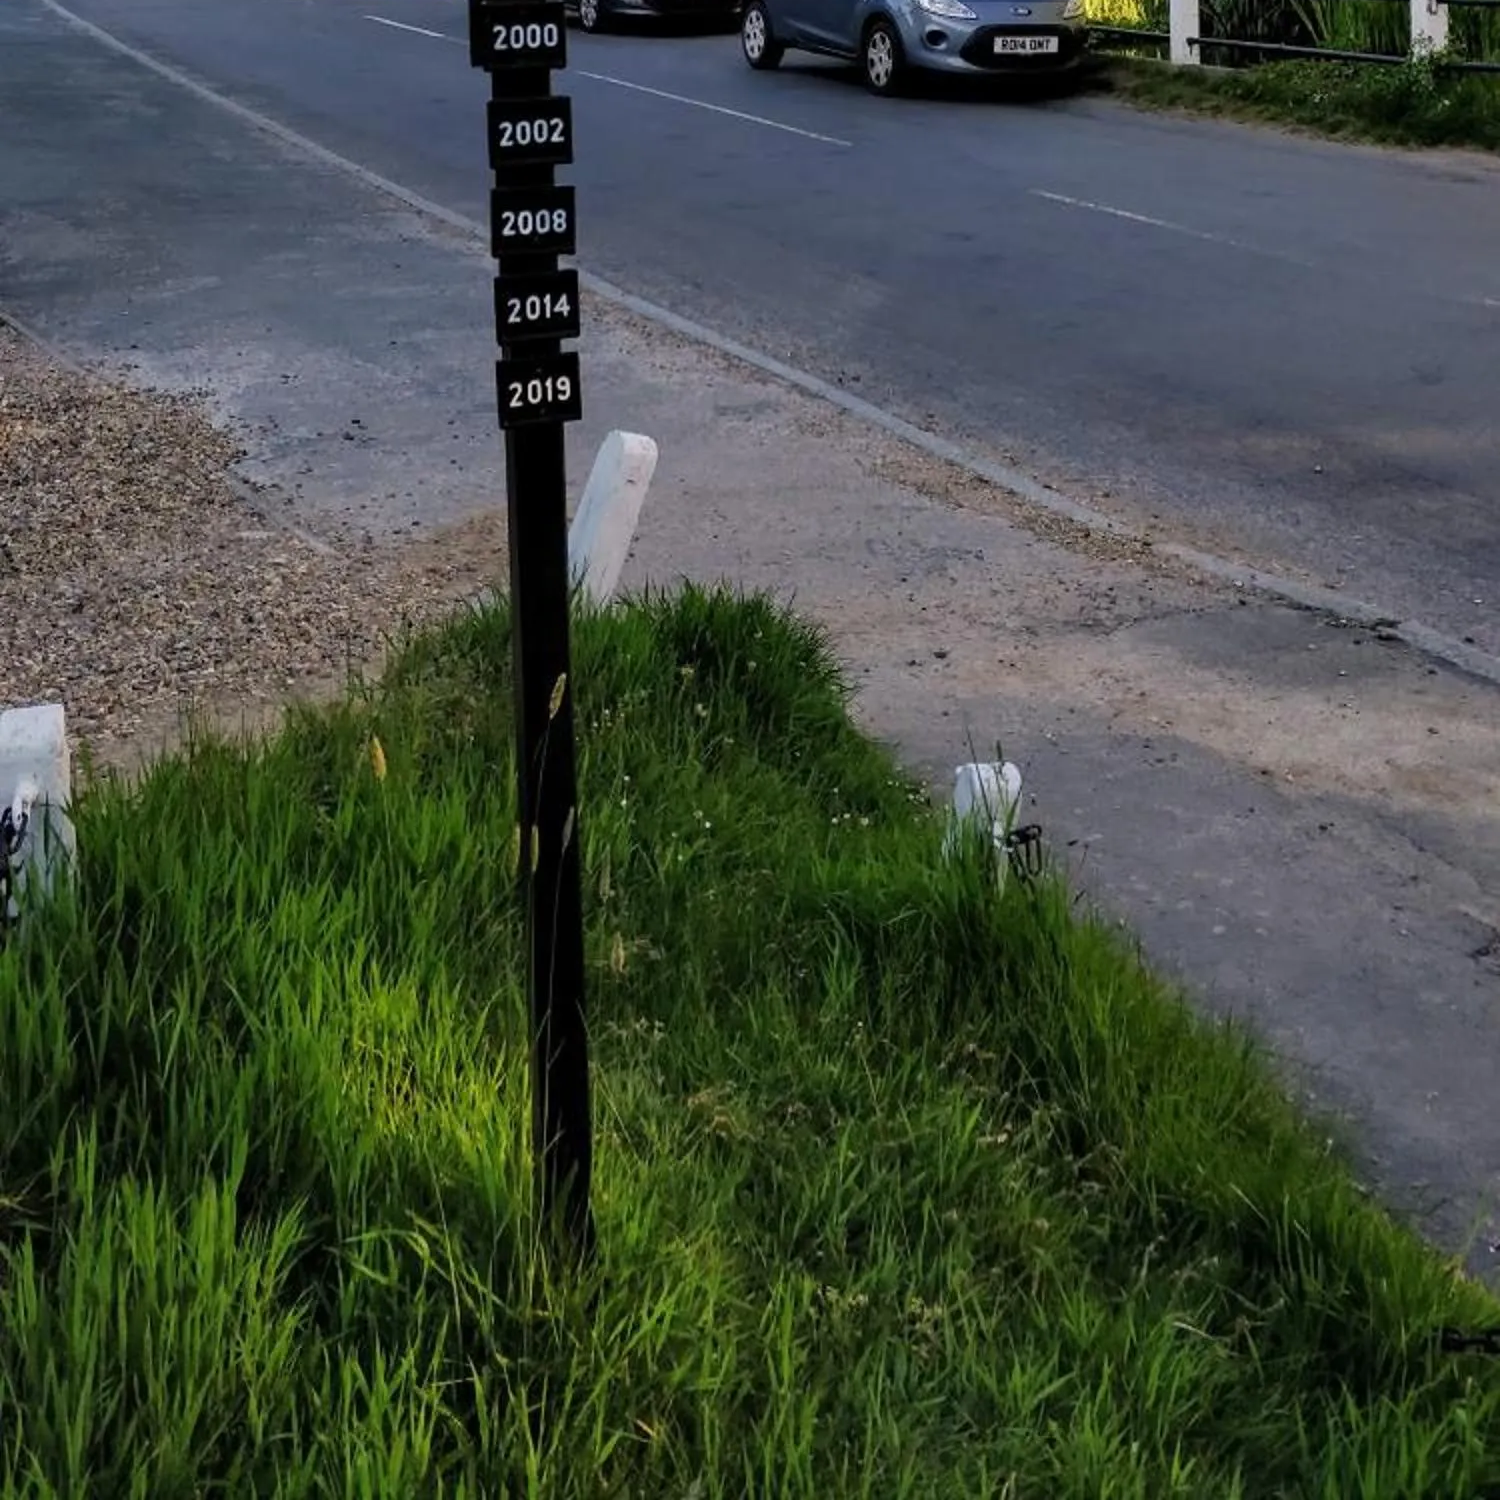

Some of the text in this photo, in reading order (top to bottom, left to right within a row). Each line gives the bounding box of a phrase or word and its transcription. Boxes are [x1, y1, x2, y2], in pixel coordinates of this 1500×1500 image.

[493, 23, 558, 50] 2000
[499, 117, 565, 147] 2002
[501, 209, 567, 236] 2008
[507, 293, 571, 323] 2014
[508, 375, 570, 408] 2019
